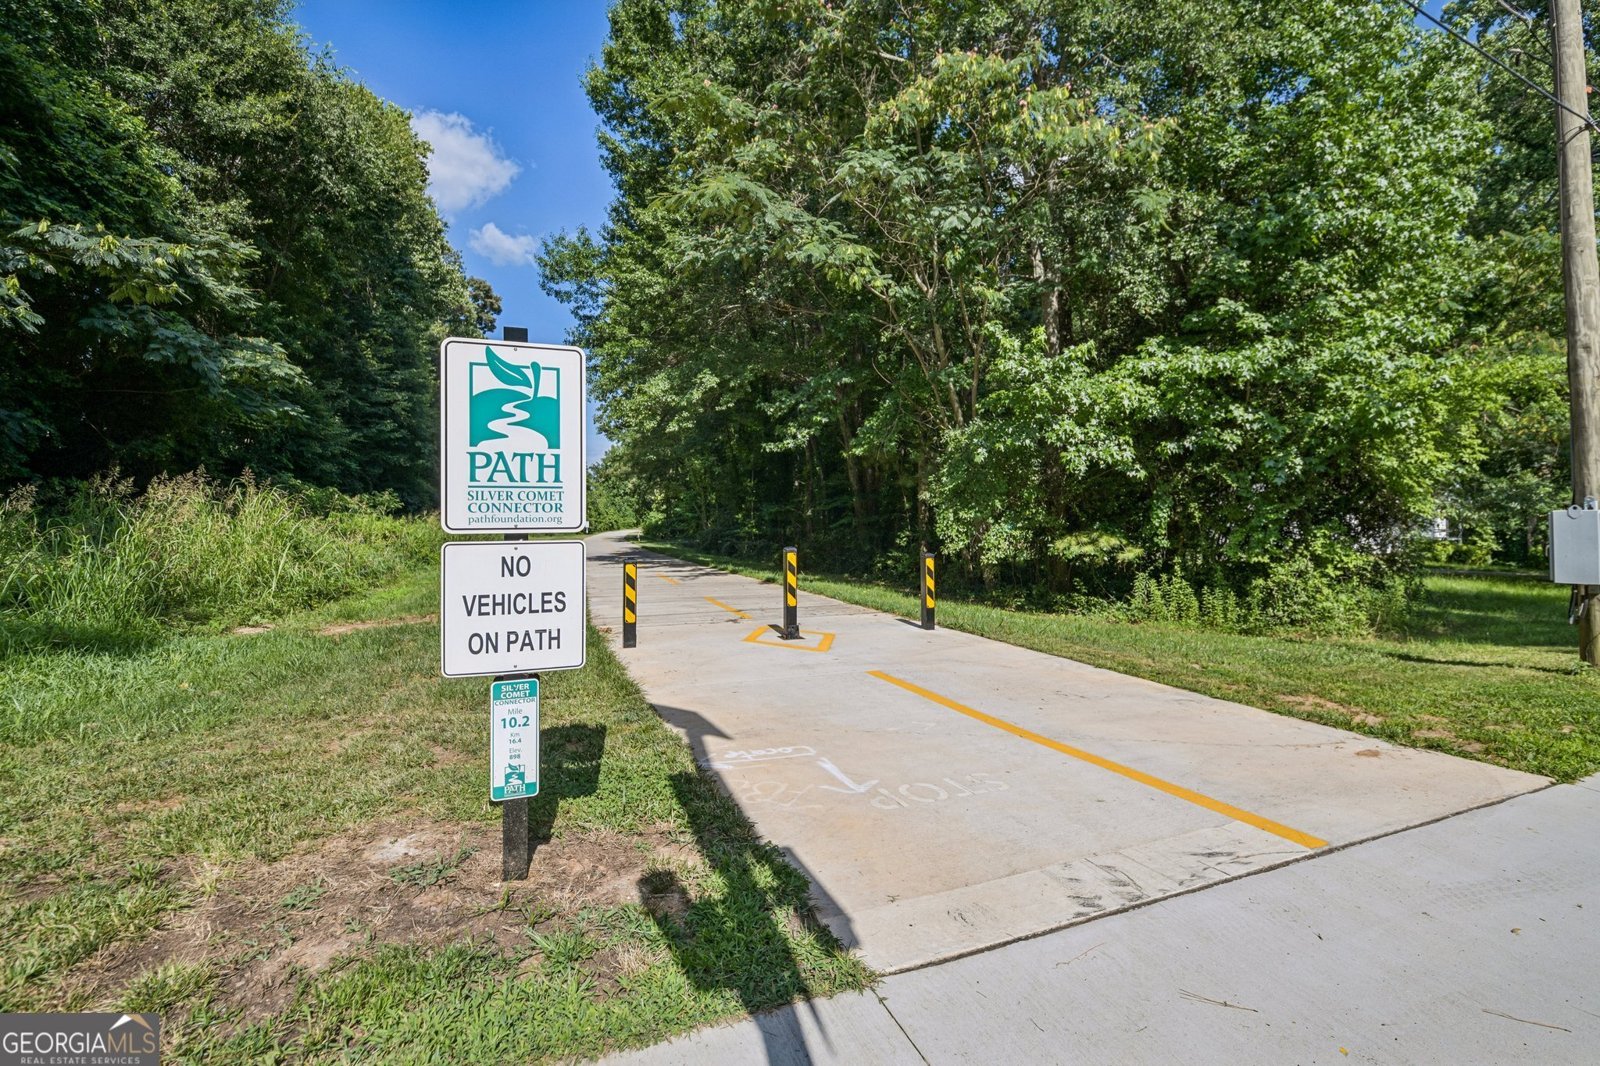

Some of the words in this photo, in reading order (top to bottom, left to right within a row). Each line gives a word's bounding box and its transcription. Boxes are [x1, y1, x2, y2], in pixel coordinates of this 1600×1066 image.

[466, 451, 563, 483] PATH
[467, 490, 514, 501] SILVER
[517, 490, 564, 501] COMET
[467, 502, 563, 513] CONNECTOR
[468, 514, 563, 525] pathfoundation.org
[501, 555, 531, 577] NO
[462, 591, 567, 617] VEHICLES
[468, 631, 499, 655] ON
[506, 628, 561, 653] PATH
[501, 683, 530, 691] SILVER
[500, 690, 531, 699] COMET
[494, 698, 536, 706] CONNECTOR
[500, 715, 530, 729] 10.2
[504, 784, 526, 794] PATH
